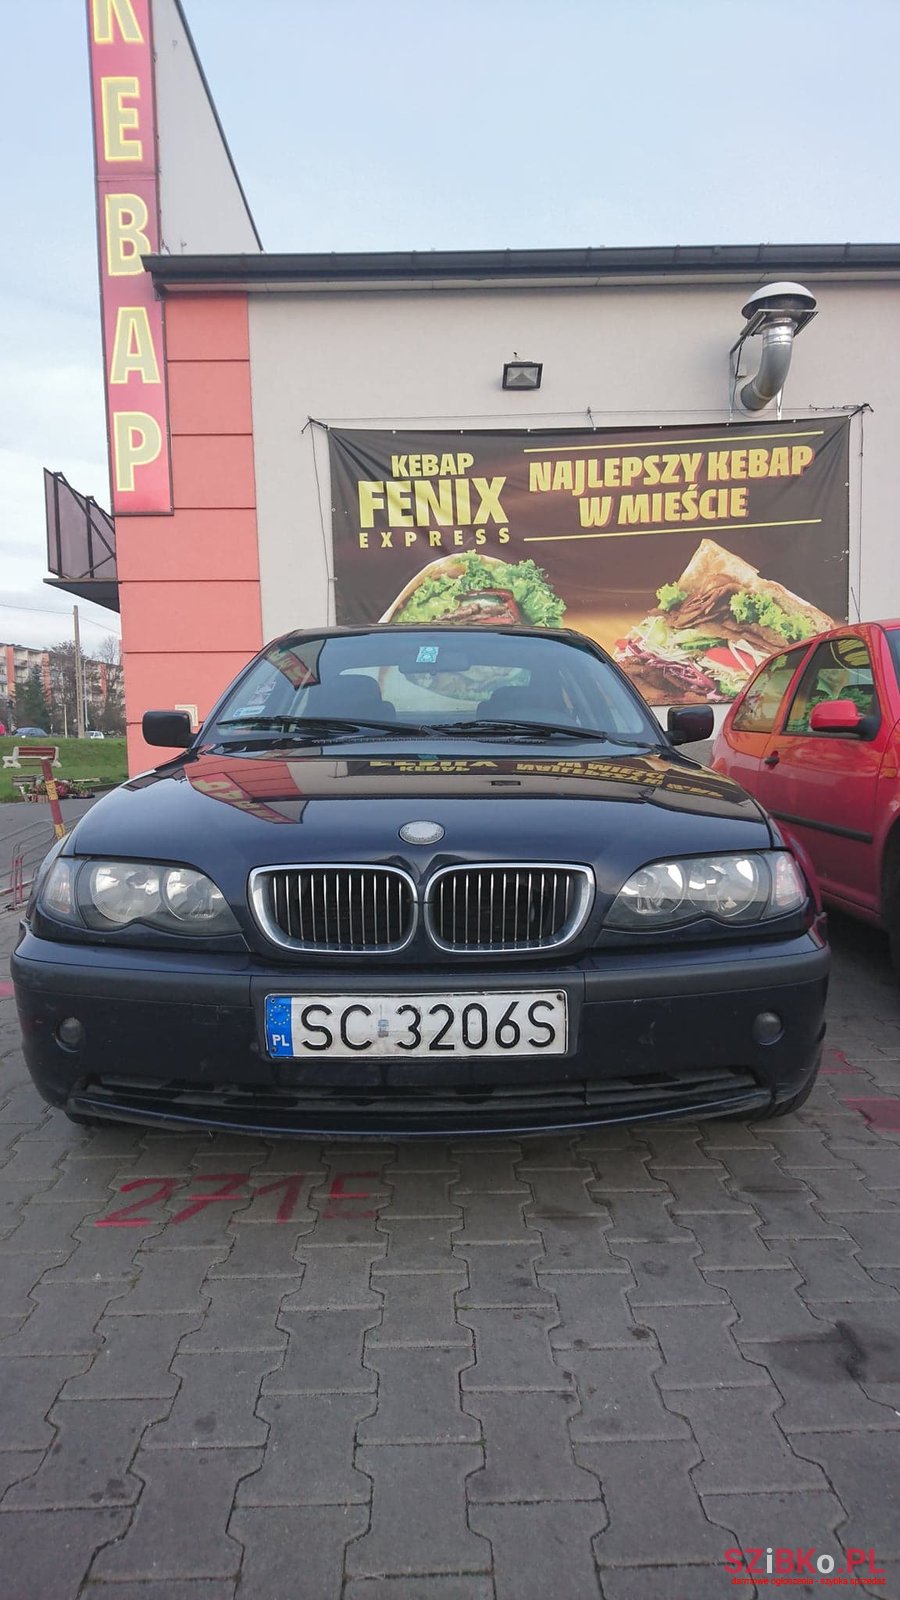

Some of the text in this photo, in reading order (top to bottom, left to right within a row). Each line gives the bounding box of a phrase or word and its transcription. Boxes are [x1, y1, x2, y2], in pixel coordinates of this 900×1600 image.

[391, 452, 474, 478] KEBAP
[529, 445, 815, 496] NAJLEPSZY KEBAP
[357, 476, 510, 529] FENIX
[579, 484, 750, 528] W MIEŚCIE
[358, 527, 511, 549] EXPRESS
[272, 1034, 290, 1047] PL
[301, 999, 556, 1051] SC 3206S
